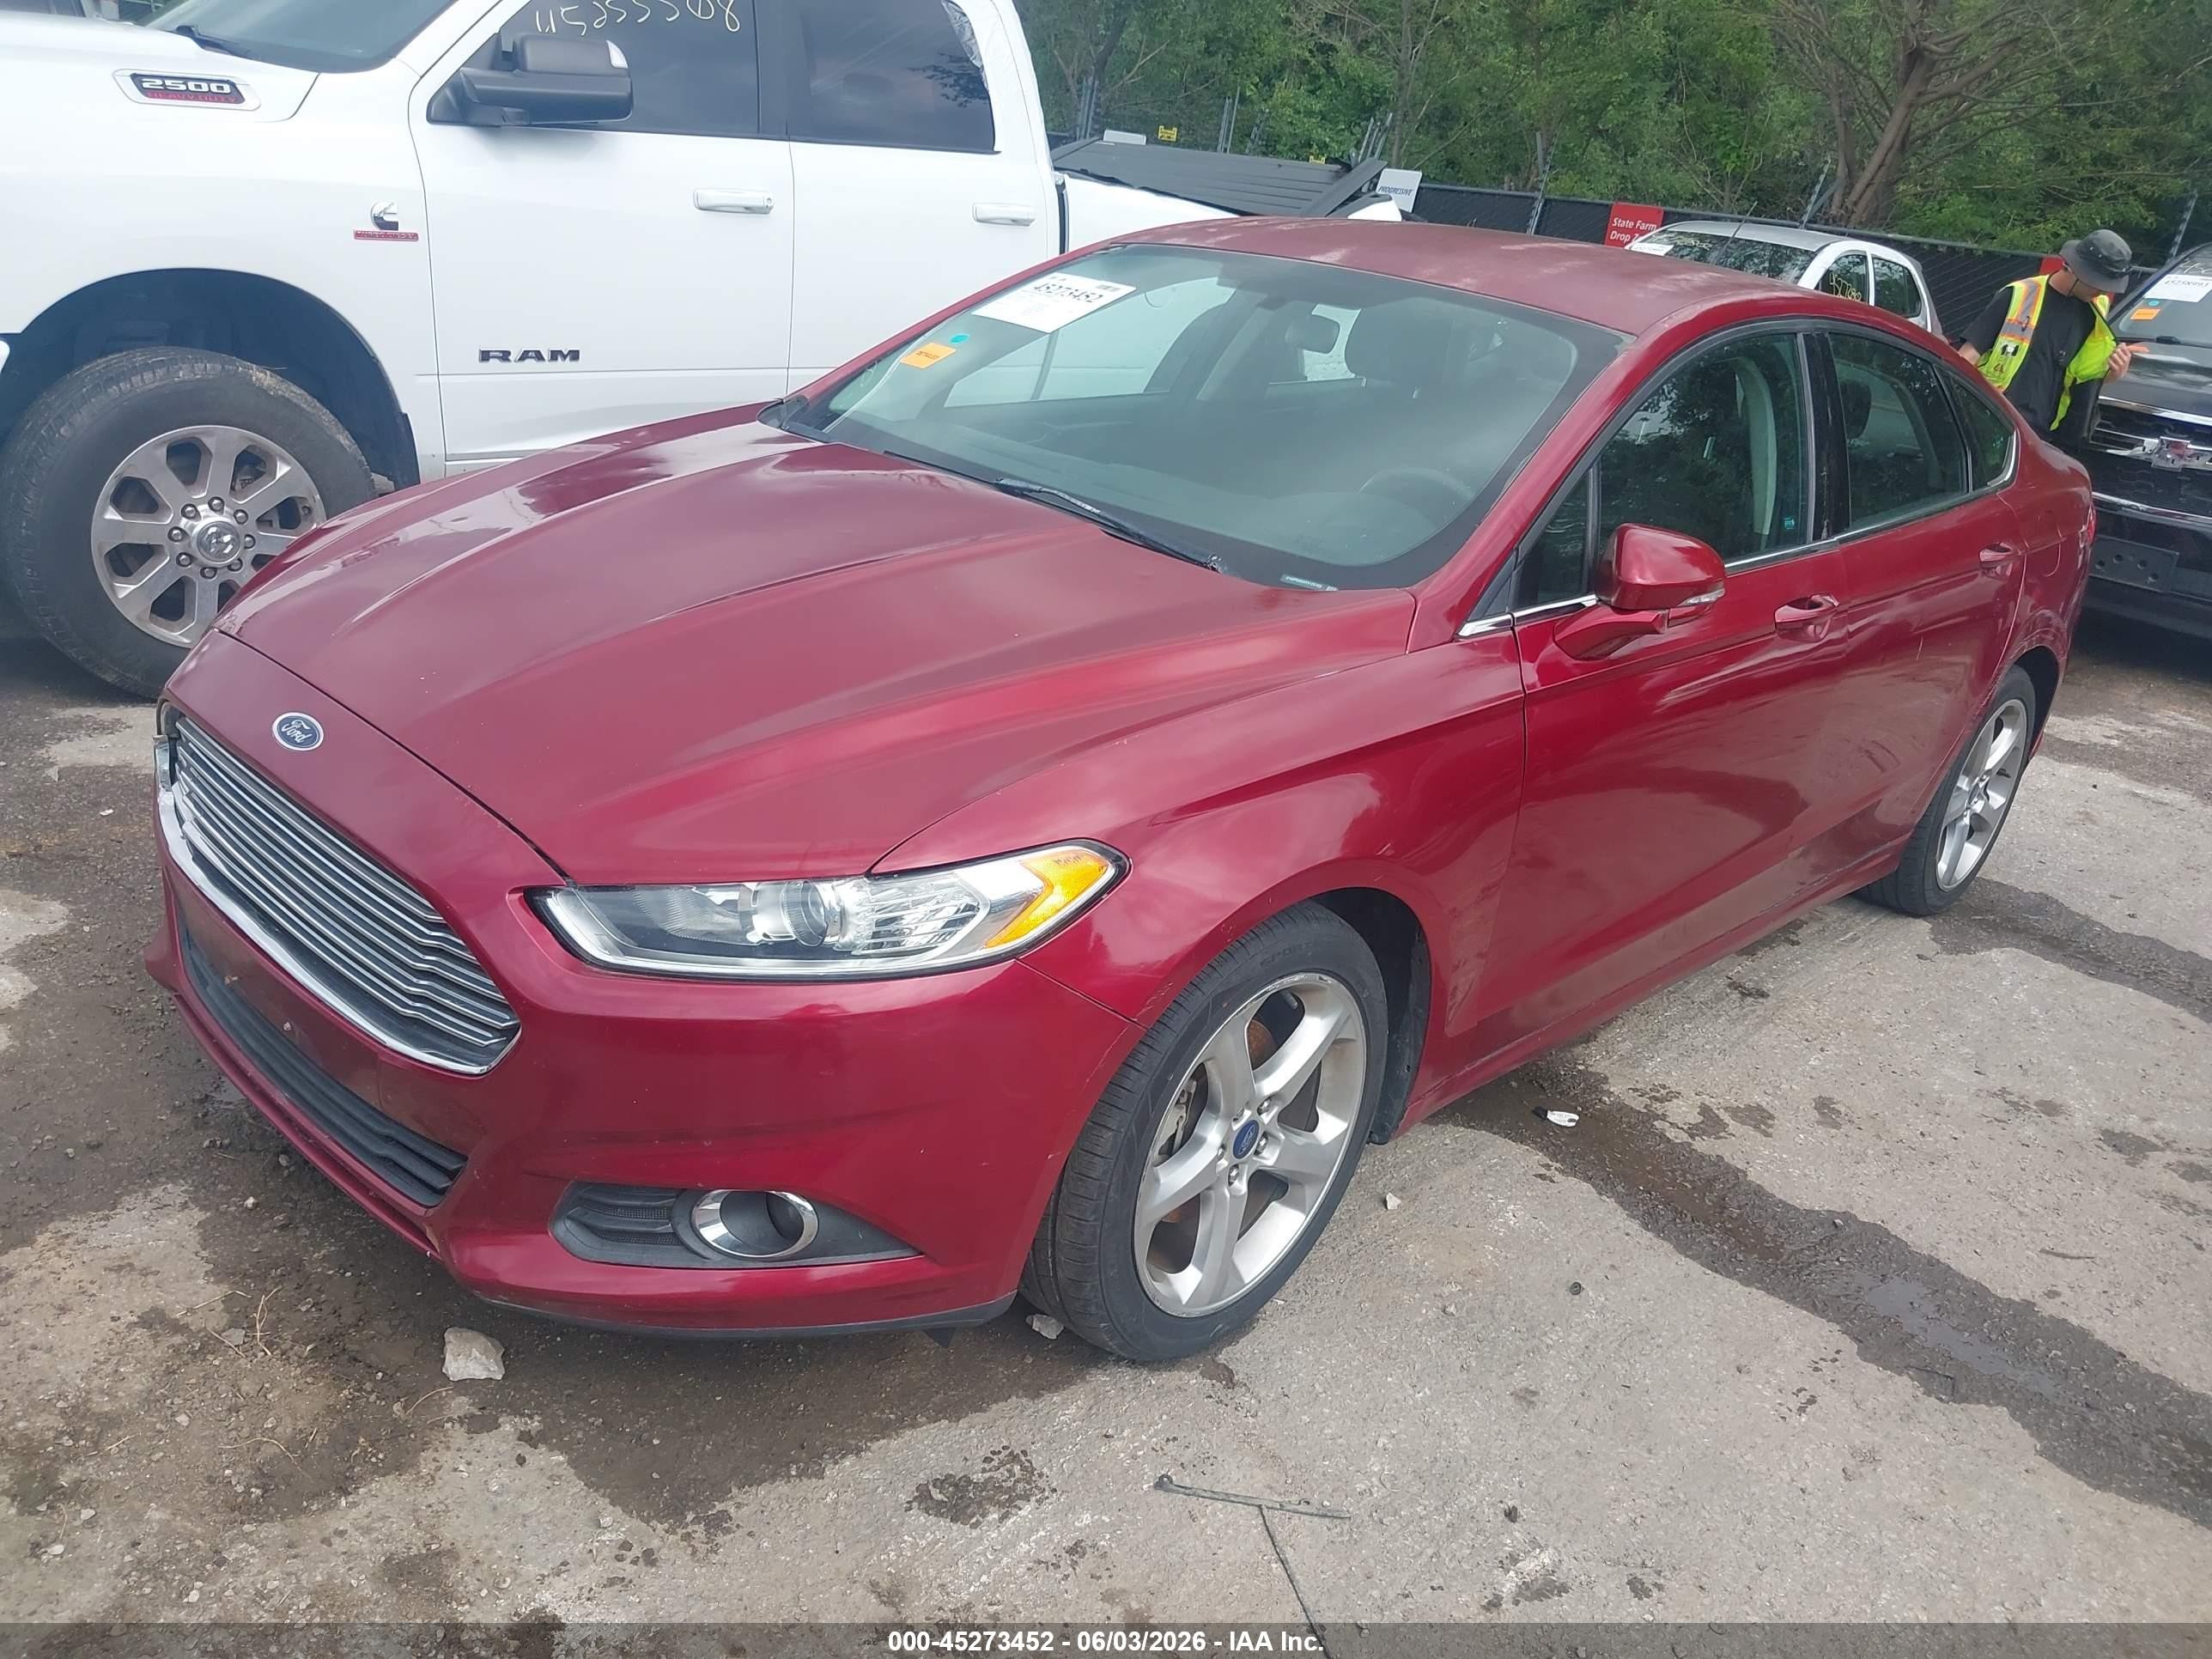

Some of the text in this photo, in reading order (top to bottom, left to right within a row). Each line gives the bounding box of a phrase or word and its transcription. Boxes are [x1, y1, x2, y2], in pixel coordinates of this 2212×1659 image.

[140, 78, 233, 94] 2500
[1377, 185, 1413, 196] PROGRESSIVE
[1612, 217, 1657, 231] State Farm
[1610, 230, 1631, 242] Drop
[478, 349, 580, 362] RAM
[281, 719, 313, 743] Ford
